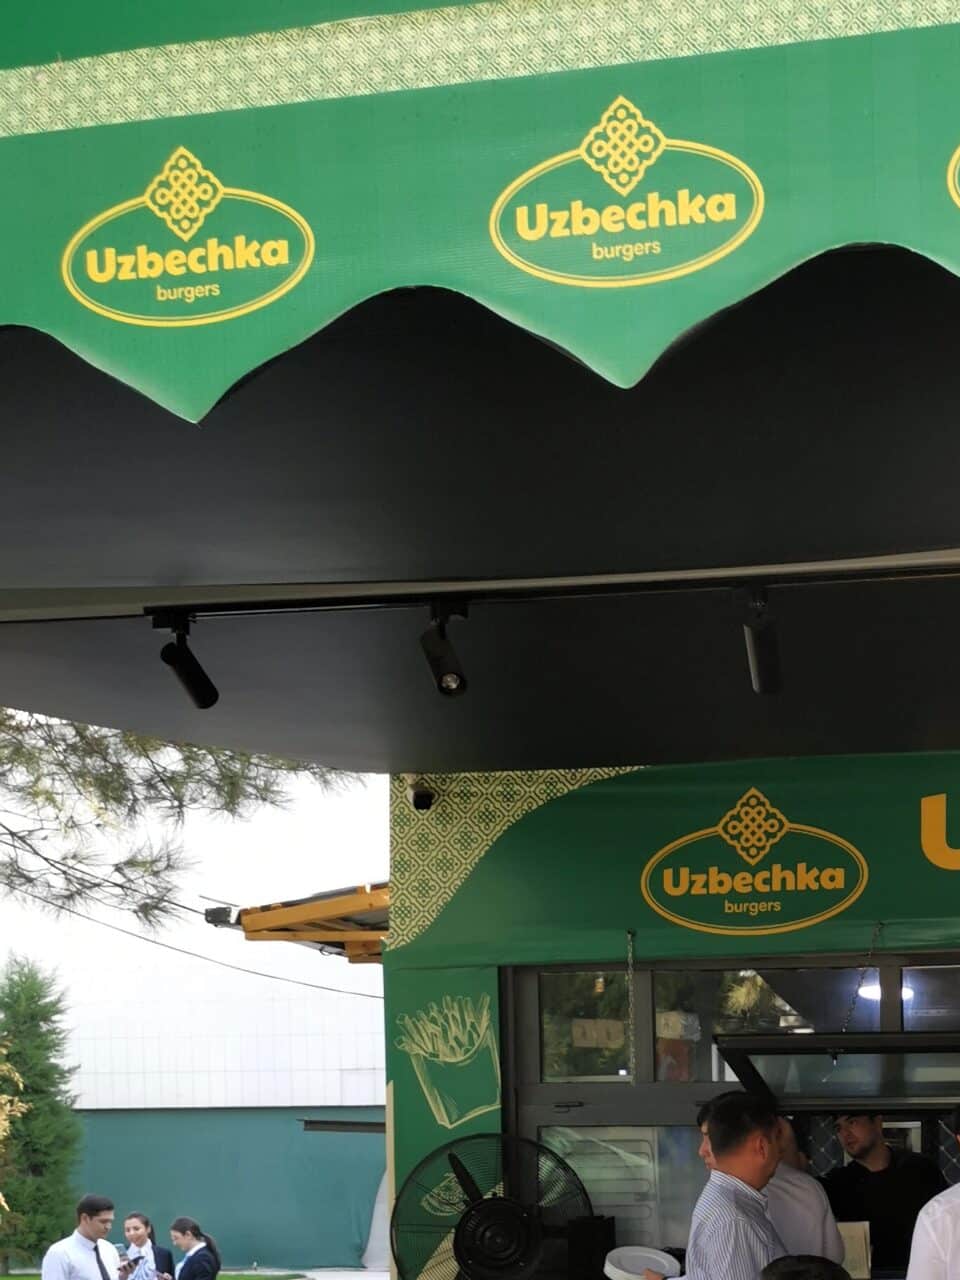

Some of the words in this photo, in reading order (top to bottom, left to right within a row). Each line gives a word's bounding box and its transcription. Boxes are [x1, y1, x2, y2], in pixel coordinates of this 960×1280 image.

[515, 190, 737, 241] Uzbechka
[86, 237, 289, 283] Uzbechka
[592, 240, 661, 261] burgers
[157, 283, 220, 302] burgers
[663, 863, 845, 896] Uzbechka
[723, 899, 782, 915] burgers
